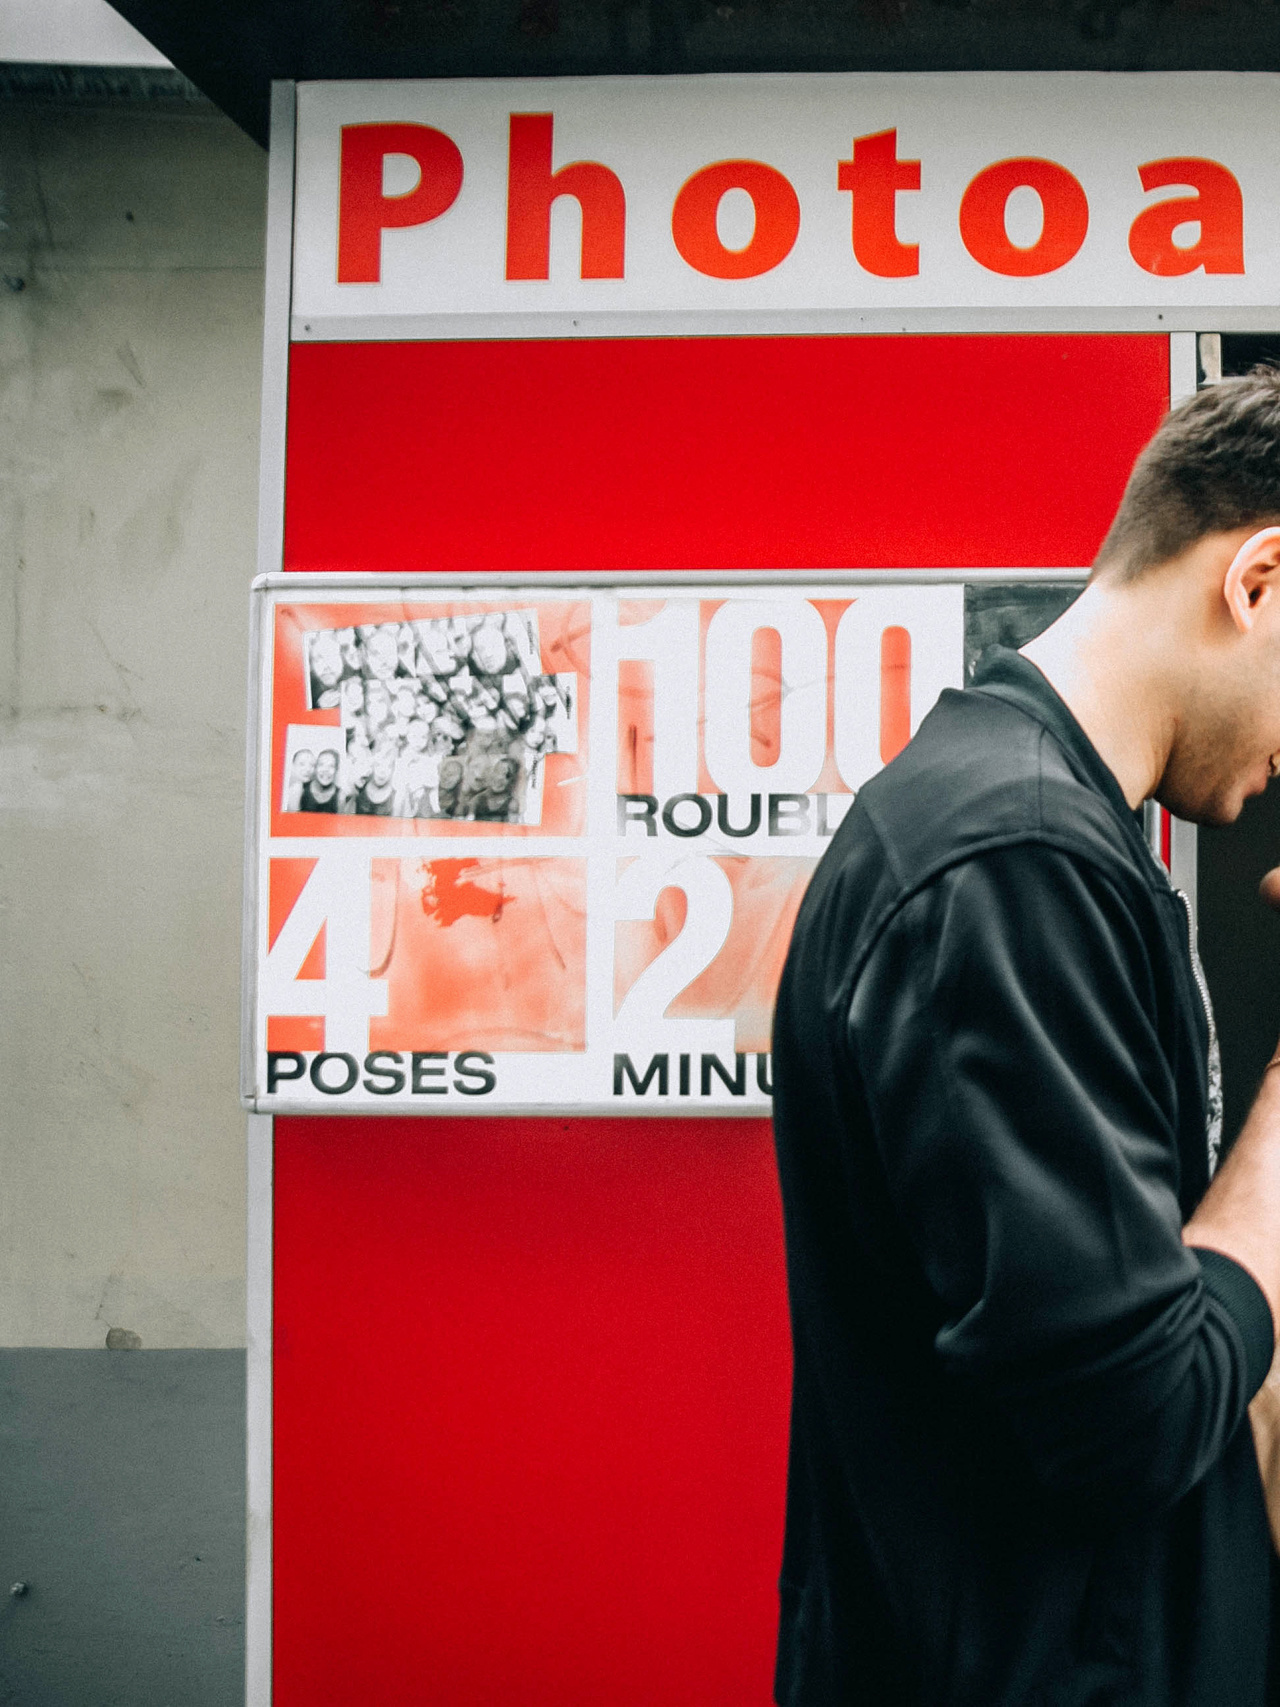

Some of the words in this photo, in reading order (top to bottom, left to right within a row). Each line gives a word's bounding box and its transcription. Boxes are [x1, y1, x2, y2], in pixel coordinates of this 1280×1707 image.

[617, 598, 957, 794] 100
[266, 857, 390, 1053] 4
[613, 857, 736, 1053] 2
[266, 1051, 497, 1095] POSES
